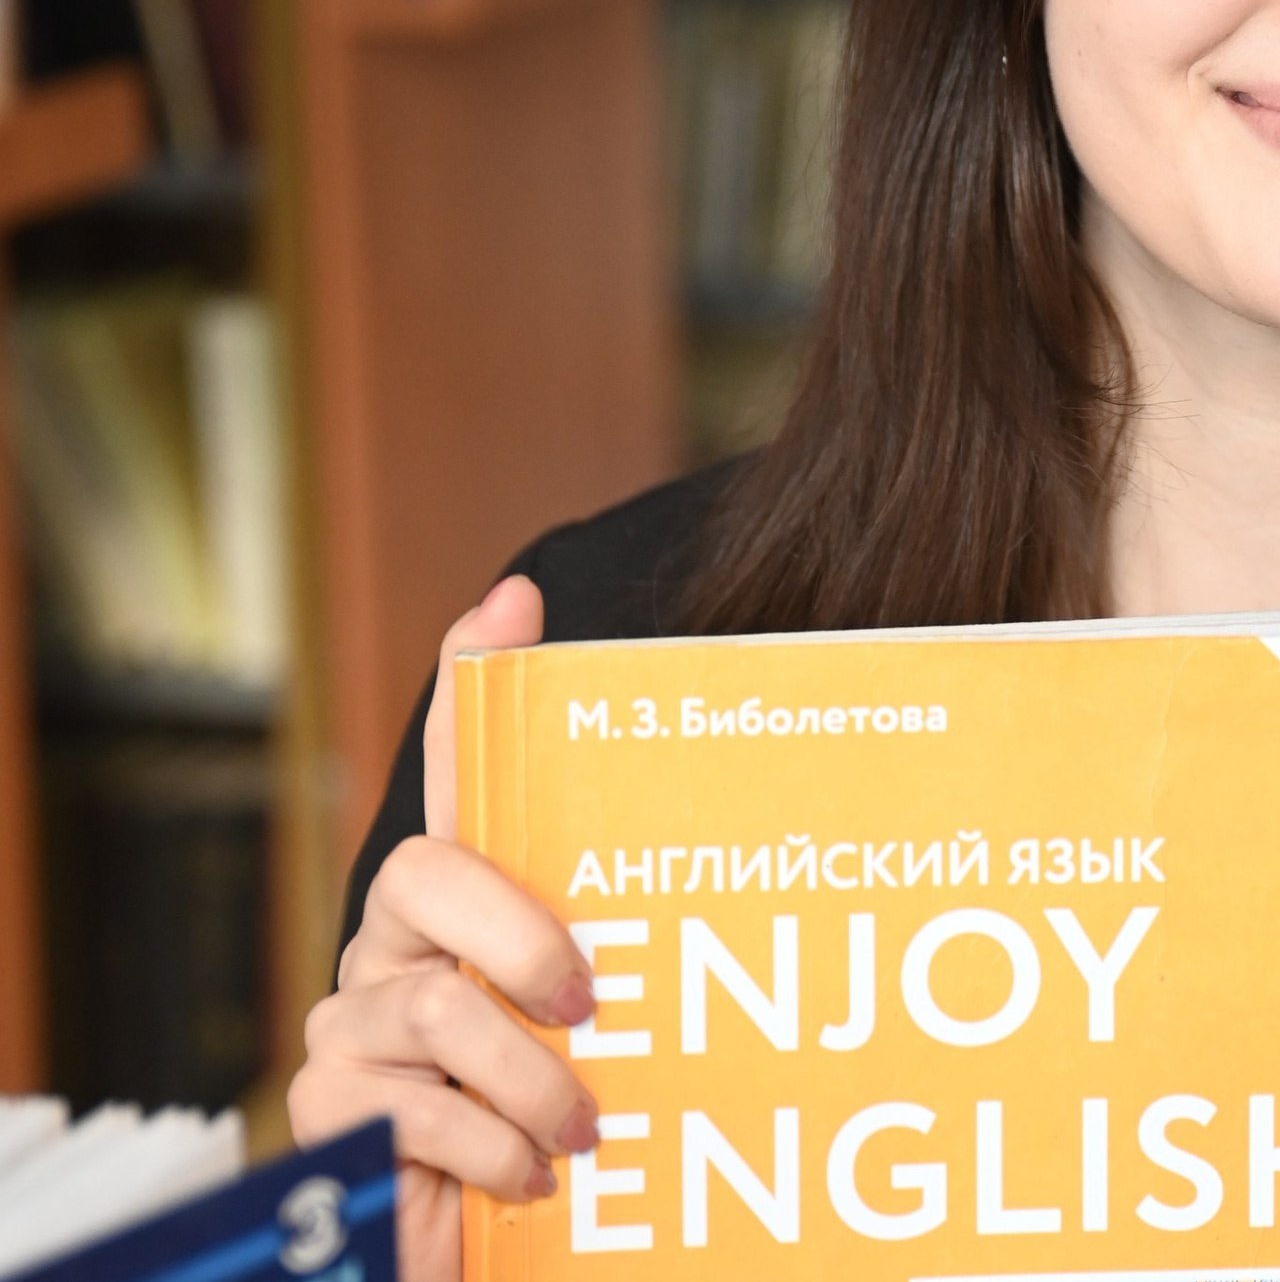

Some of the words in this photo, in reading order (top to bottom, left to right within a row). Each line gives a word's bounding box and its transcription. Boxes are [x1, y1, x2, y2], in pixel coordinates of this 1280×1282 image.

[567, 699, 622, 741] М.
[630, 697, 670, 739] З.
[680, 696, 948, 738] Биболетова
[566, 829, 989, 898] АНГЛИЙСКИЙ
[1006, 836, 1167, 885] ЯЗЫК
[568, 906, 1160, 1059] ENJOY
[277, 1177, 349, 1276] 3
